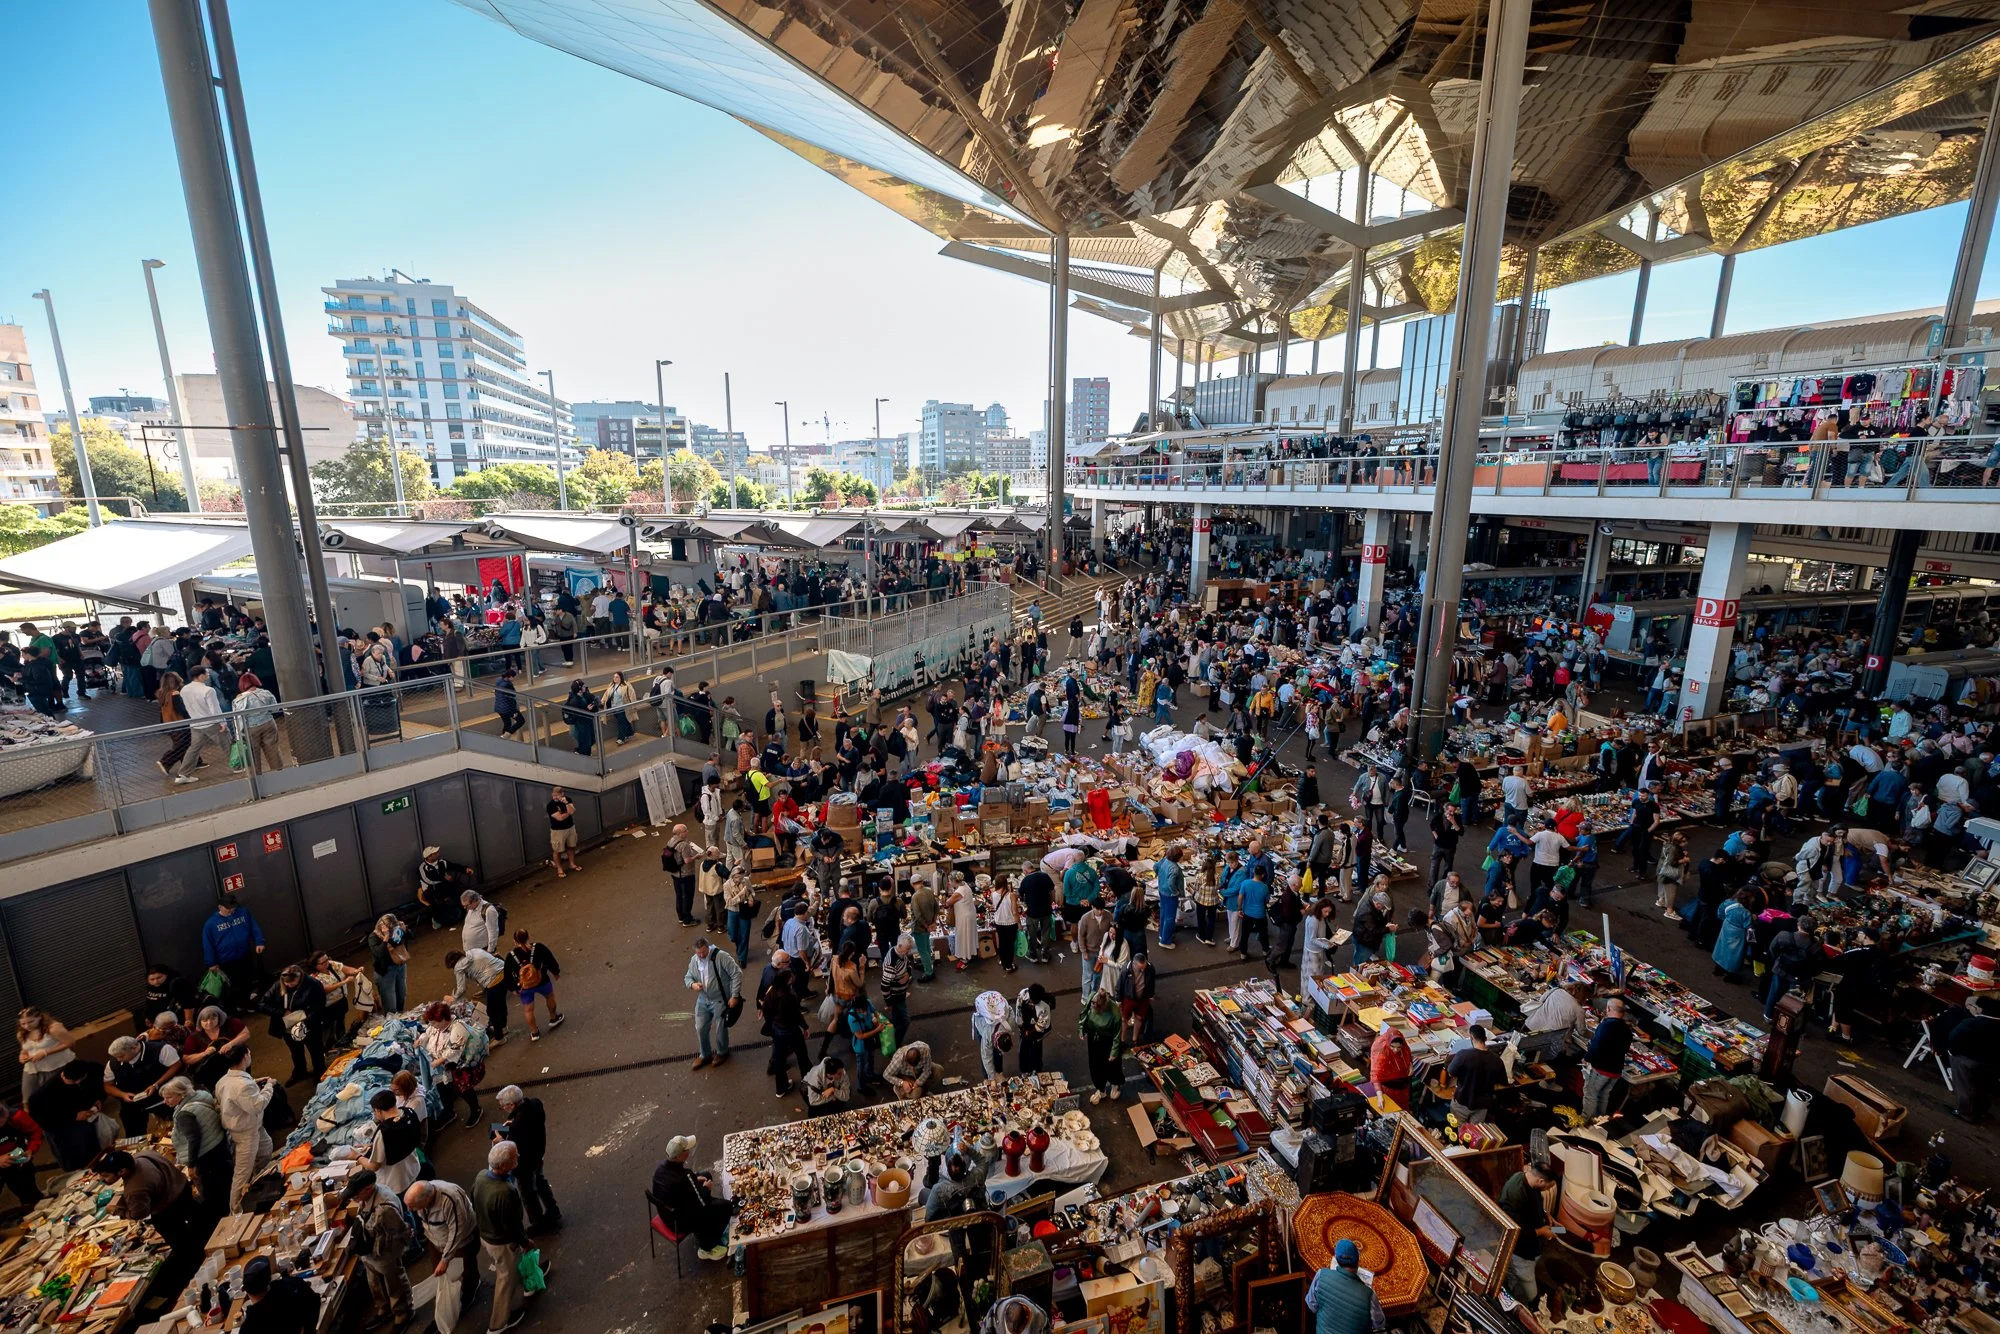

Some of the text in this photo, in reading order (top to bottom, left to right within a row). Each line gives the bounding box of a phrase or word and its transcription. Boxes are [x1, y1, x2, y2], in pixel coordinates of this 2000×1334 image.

[1195, 519, 1200, 528] D
[1201, 519, 1209, 528] D
[1364, 546, 1372, 558] D
[1376, 546, 1385, 558] D
[1701, 600, 1718, 617] D
[1725, 601, 1736, 619] D
[1867, 657, 1879, 668] D
